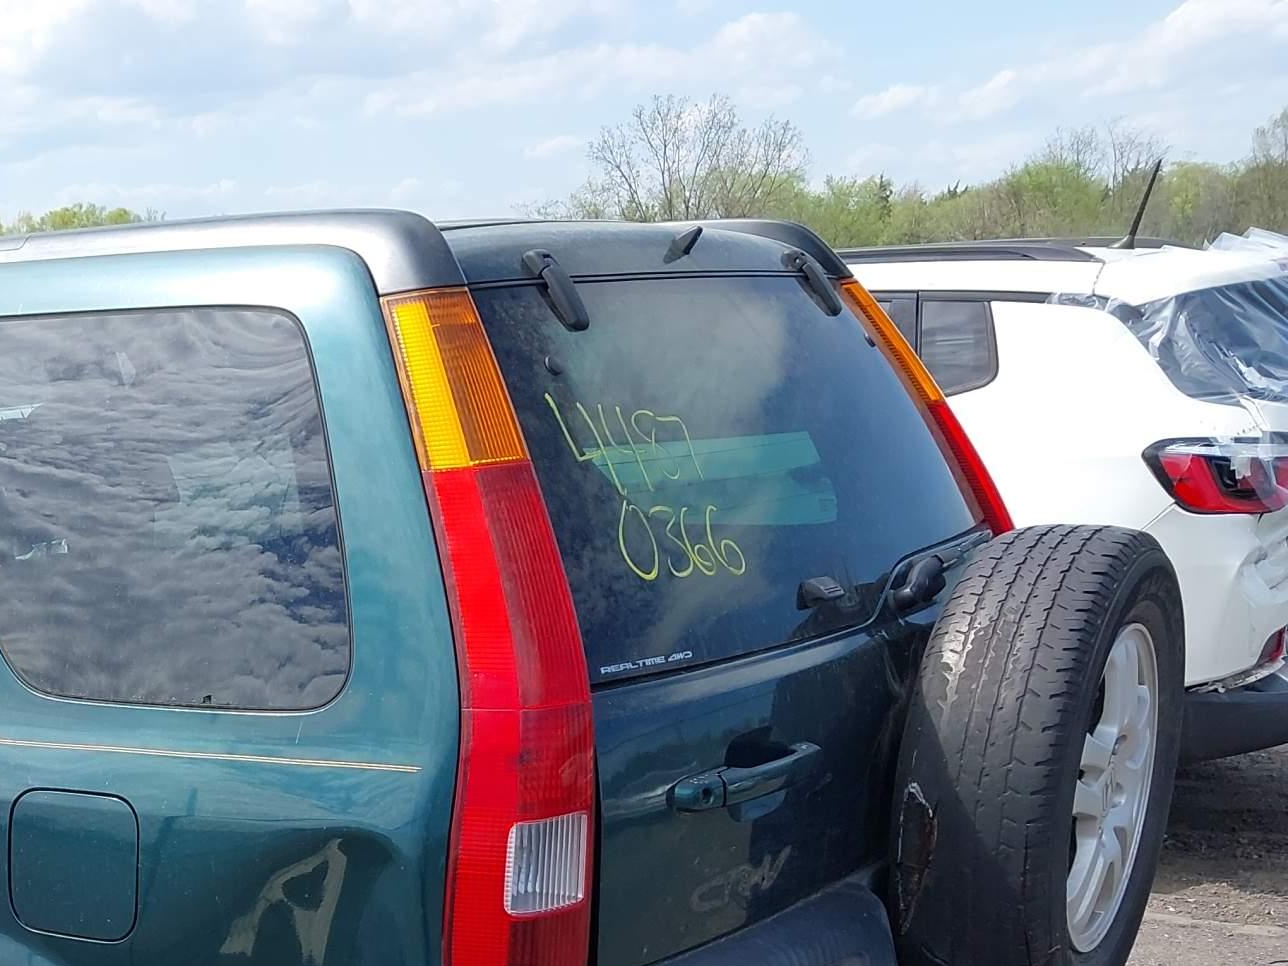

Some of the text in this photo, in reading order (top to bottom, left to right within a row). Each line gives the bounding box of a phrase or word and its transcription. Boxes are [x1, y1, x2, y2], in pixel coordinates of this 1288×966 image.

[544, 393, 704, 496] 4487
[618, 500, 746, 581] 0366
[599, 650, 694, 675] REALTIME 4WD
